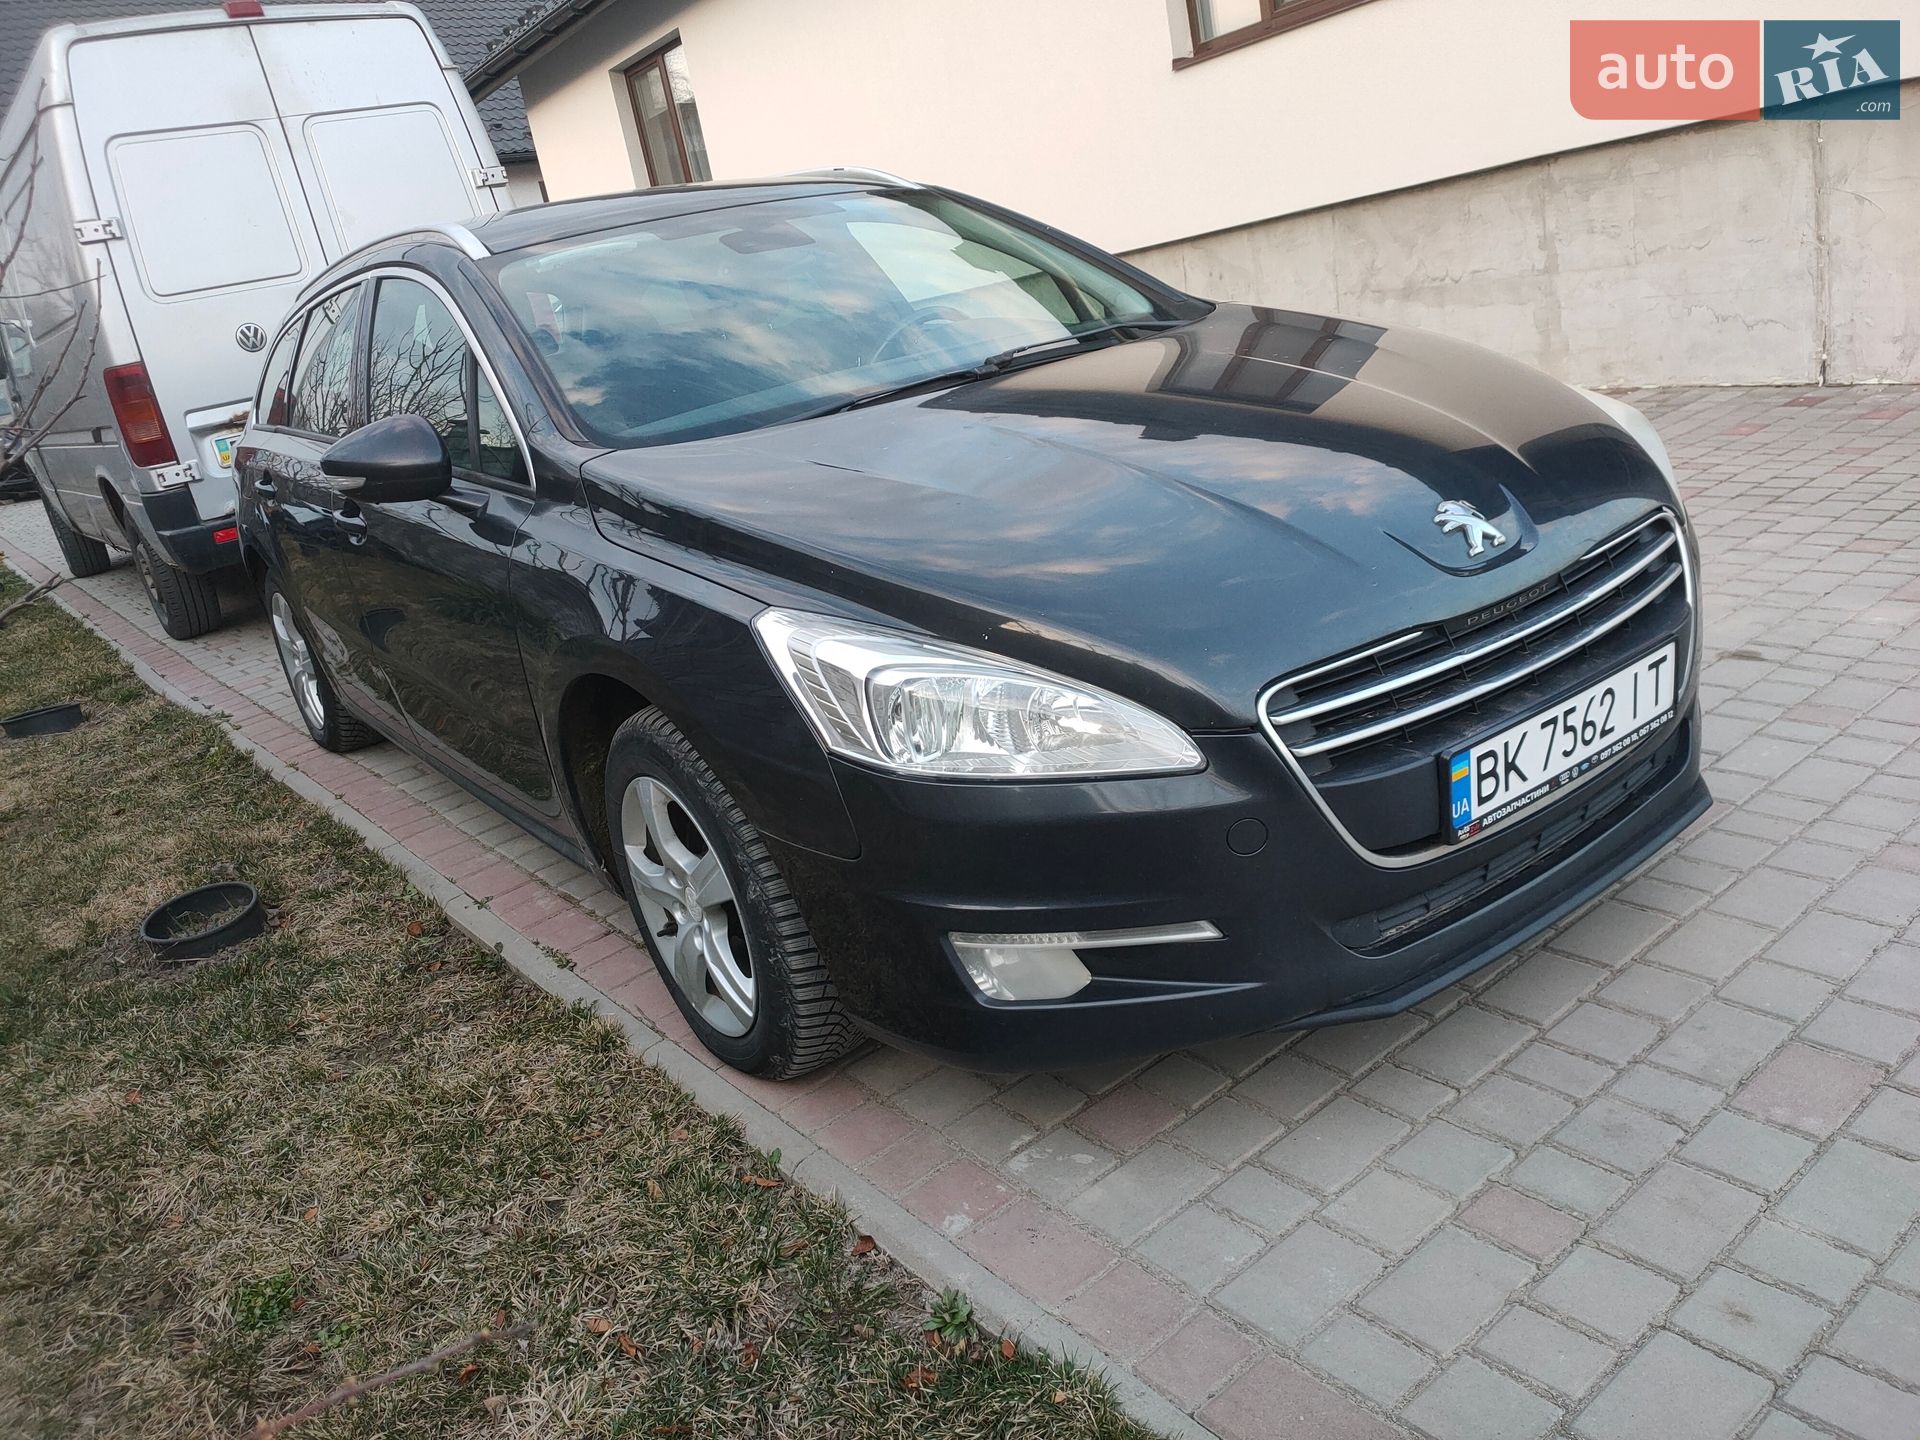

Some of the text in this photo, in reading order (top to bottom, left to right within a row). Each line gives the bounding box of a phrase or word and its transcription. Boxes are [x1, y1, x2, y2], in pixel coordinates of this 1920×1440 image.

[1466, 583, 1549, 626] PEUGEOT
[1476, 654, 1668, 807] BK 7562 IT
[1452, 797, 1469, 818] UA
[1482, 784, 1550, 827] АВТОЗАПЧАСТИНИ
